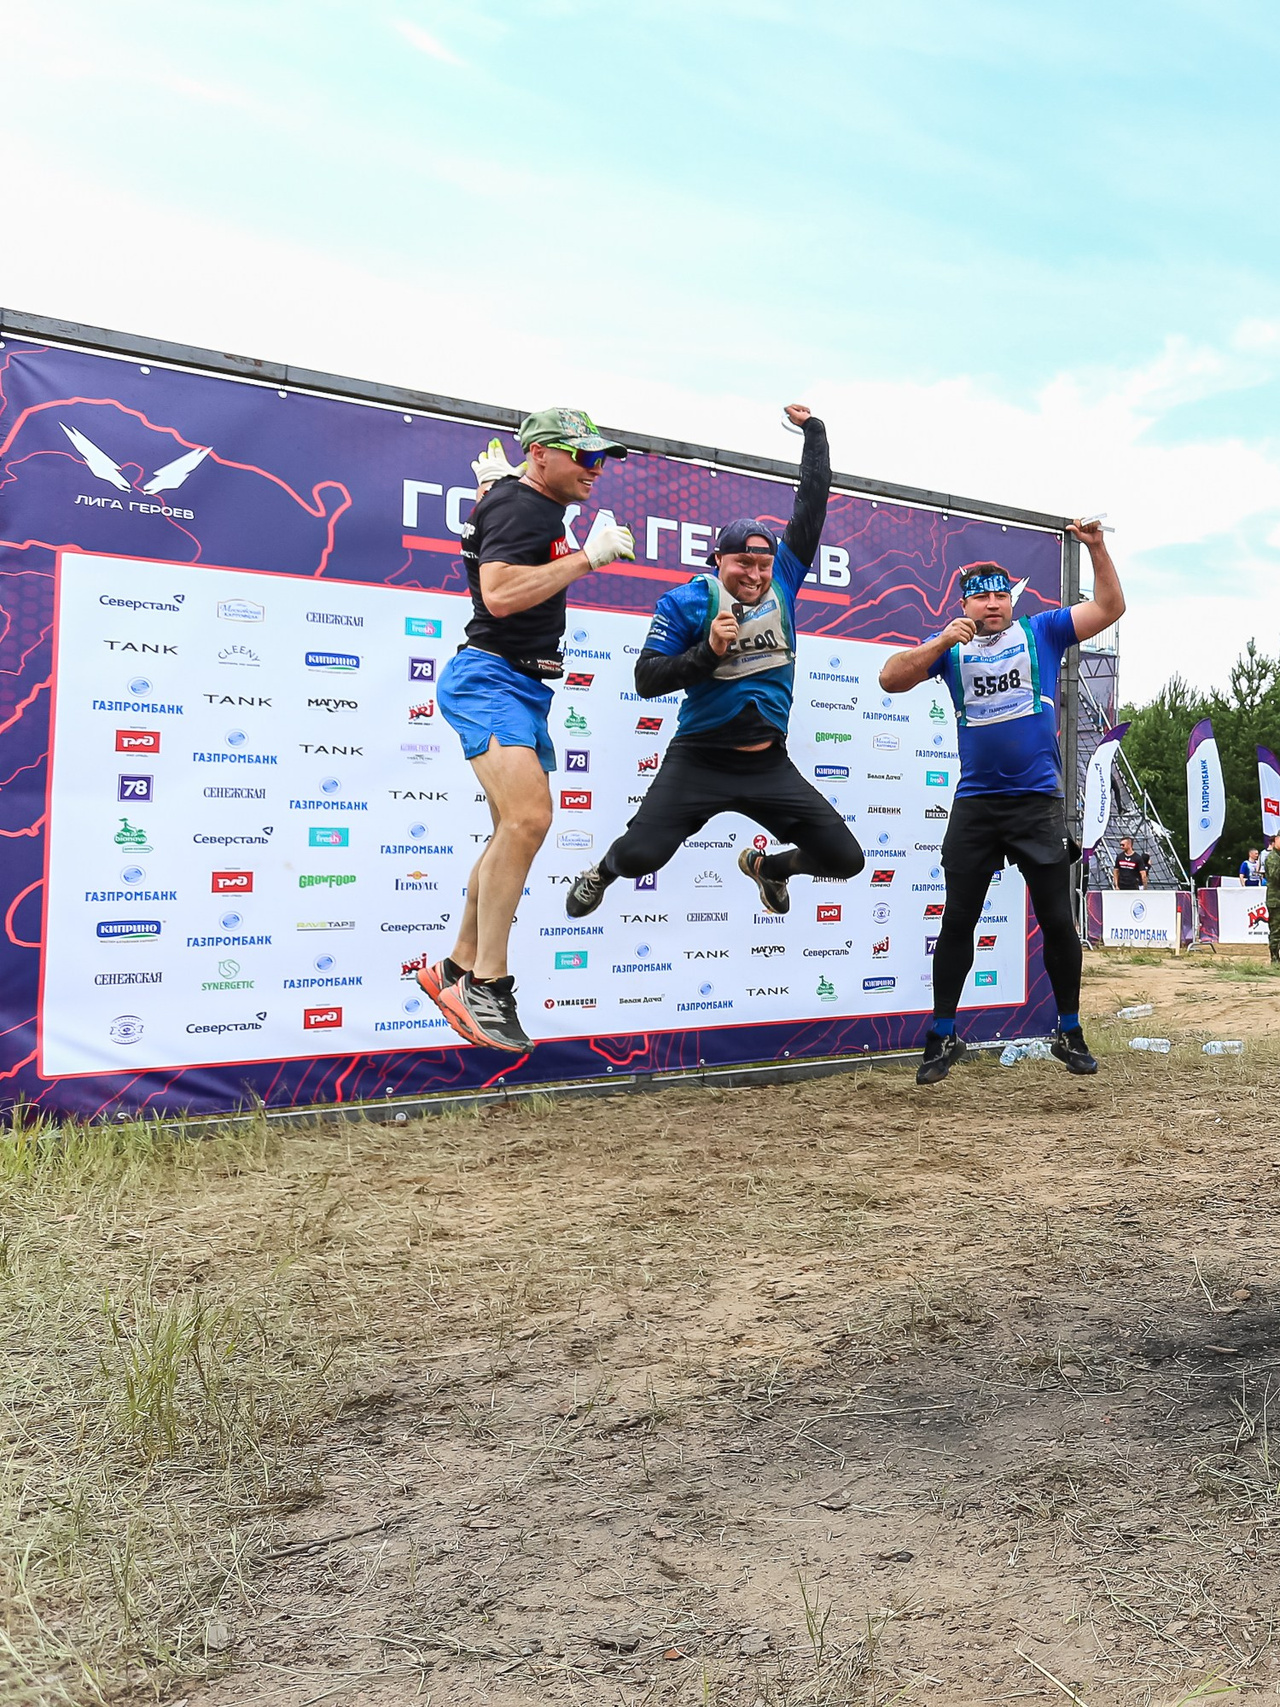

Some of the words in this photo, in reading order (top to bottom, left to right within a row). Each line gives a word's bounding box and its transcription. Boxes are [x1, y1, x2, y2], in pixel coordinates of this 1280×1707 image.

[75, 494, 123, 510] ЛИГА
[129, 500, 195, 520] ГЕРОЕВ
[646, 516, 852, 588] ГЕВ
[99, 595, 180, 611] Северсталь
[306, 612, 364, 627] СЕНЕЖСКАЯ
[103, 640, 178, 655] TANK
[218, 645, 260, 661] CLEENY
[308, 654, 357, 666] КИПРИНО
[412, 662, 432, 678] 78
[809, 672, 859, 684] ГАЗПРОМБАНК
[973, 668, 1021, 697] 5588
[203, 694, 274, 708] TANK
[307, 698, 358, 711] МАГУРО
[811, 700, 855, 711] Северсталь
[92, 700, 184, 715] ГАЗПРОМБАНК
[863, 712, 910, 723] ГАЗПРОМБАНК
[816, 731, 852, 744] GROWFOOD
[299, 744, 364, 756] TANK
[193, 752, 278, 765] ГАЗПРОМБАНК
[568, 754, 586, 768] 78
[123, 780, 148, 796] 78
[1201, 759, 1210, 812] ГАЗПРОМБАНК
[203, 787, 266, 799] СЕНЕЖСКАЯ
[388, 790, 449, 801] TANK
[289, 800, 368, 811] ГАЗПРОМБАНК
[867, 807, 901, 815] ДНЕВНИК
[193, 833, 269, 846] Северсталь
[683, 840, 733, 850] Северсталь
[380, 845, 454, 855] ГАЗПРОМБАНК
[864, 850, 906, 858] АЗПРОМБАНК
[299, 875, 356, 889] GROWFOOD
[694, 870, 723, 884] CLEENY
[85, 891, 178, 902] ГАЗПРОМБАНК
[620, 914, 668, 923] TANK
[686, 912, 728, 922] СЕНЕЖСКАЯ
[100, 923, 158, 934] КИПРИНО
[380, 922, 446, 934] Северсталь
[540, 926, 604, 936] ГАЗПРОМБАНК
[1111, 928, 1168, 941] ГАЗПРОМБАНК
[186, 935, 273, 947] ГАЗПРОМБАНК
[683, 950, 730, 960] TANK
[751, 945, 785, 955] МАГУРО
[803, 948, 849, 958] Северсталь
[612, 963, 672, 973] ГАЗПРОМБАНК
[94, 971, 163, 986] СЕНЕЖСКАЯ
[283, 976, 363, 989] ГАЗПРОМБАНК
[201, 980, 255, 991] SYNERGETIC
[746, 987, 789, 996] TANK
[557, 998, 597, 1006] YAMAGUCHI
[677, 1000, 734, 1011] ГАЗПРОМБАНК
[186, 1021, 262, 1035] Северсталь
